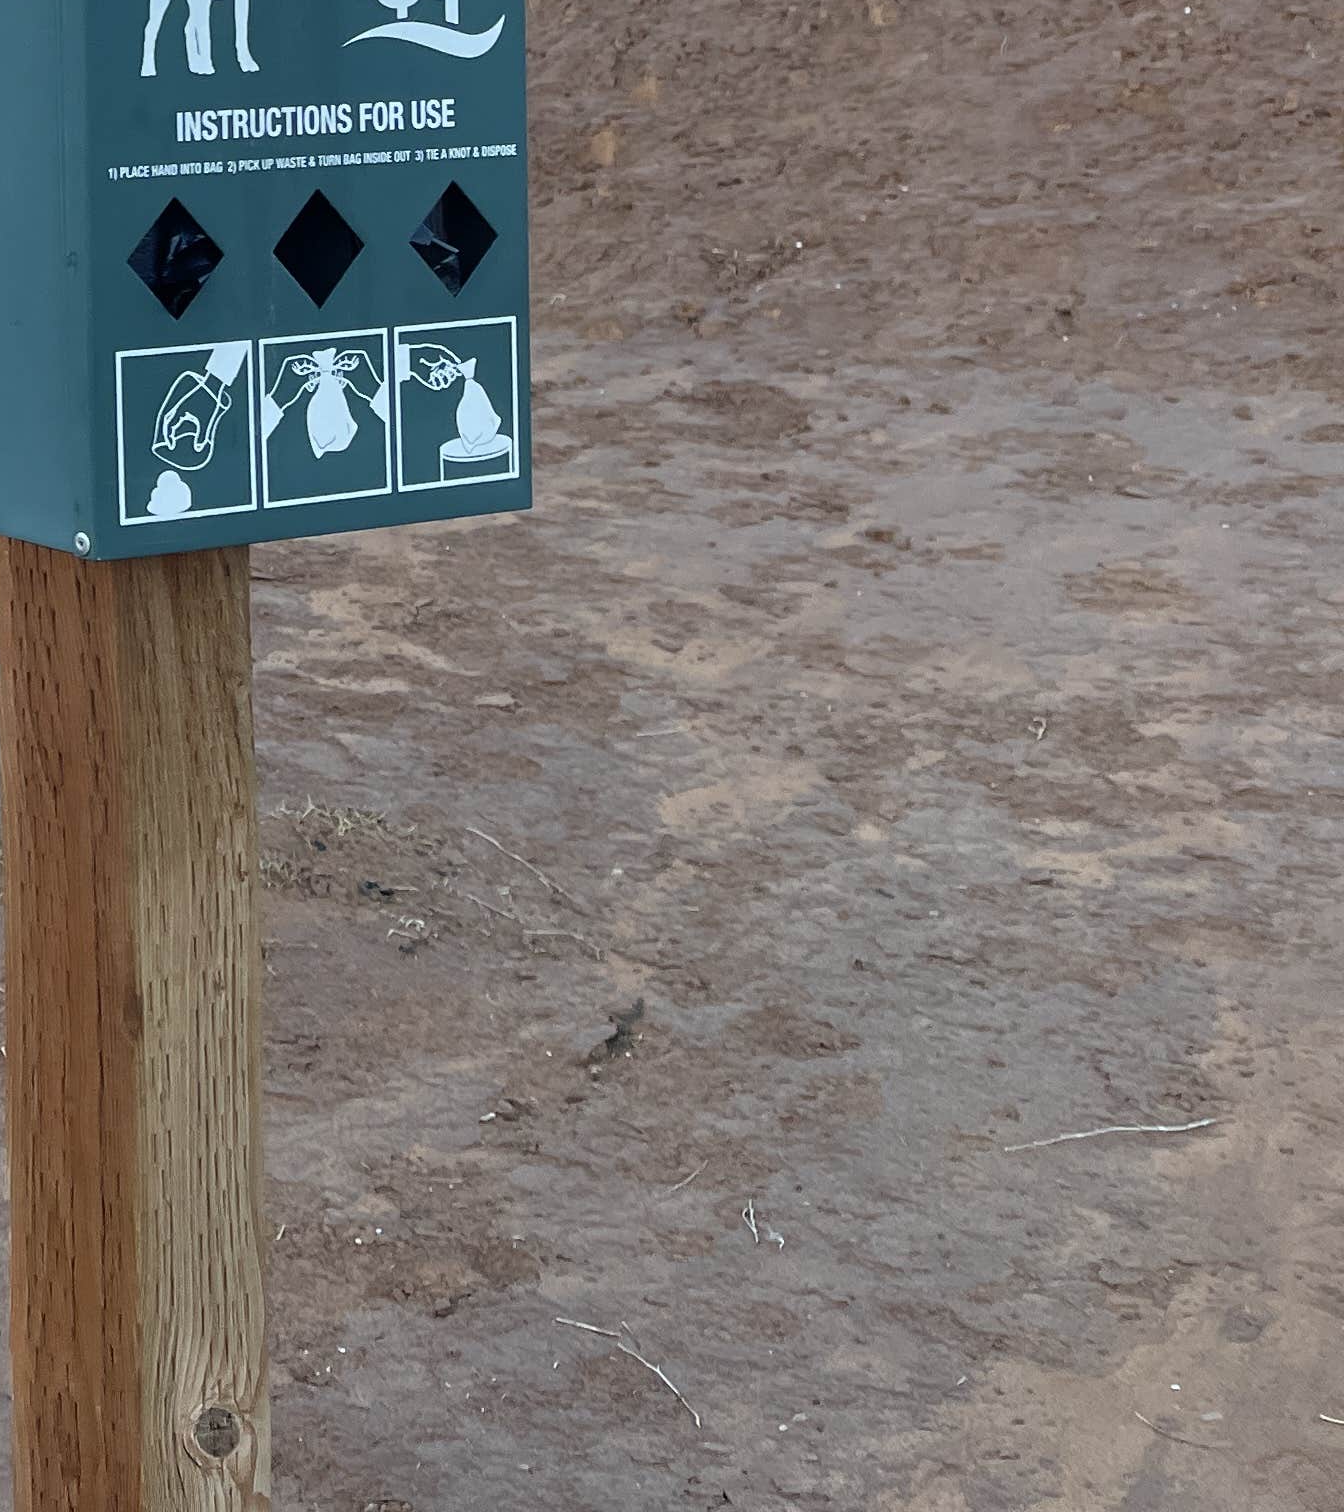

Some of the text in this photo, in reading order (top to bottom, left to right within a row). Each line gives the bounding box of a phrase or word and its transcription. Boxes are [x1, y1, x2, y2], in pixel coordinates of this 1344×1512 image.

[175, 98, 456, 143] INSTRUCTIONS FOR USE
[108, 143, 518, 181] 1) PLACE HAND INTO BAG 2) PICK UP WASTE & TURN BAG INSIDE OUT 3) TIE A KNOT & DISPOSE
